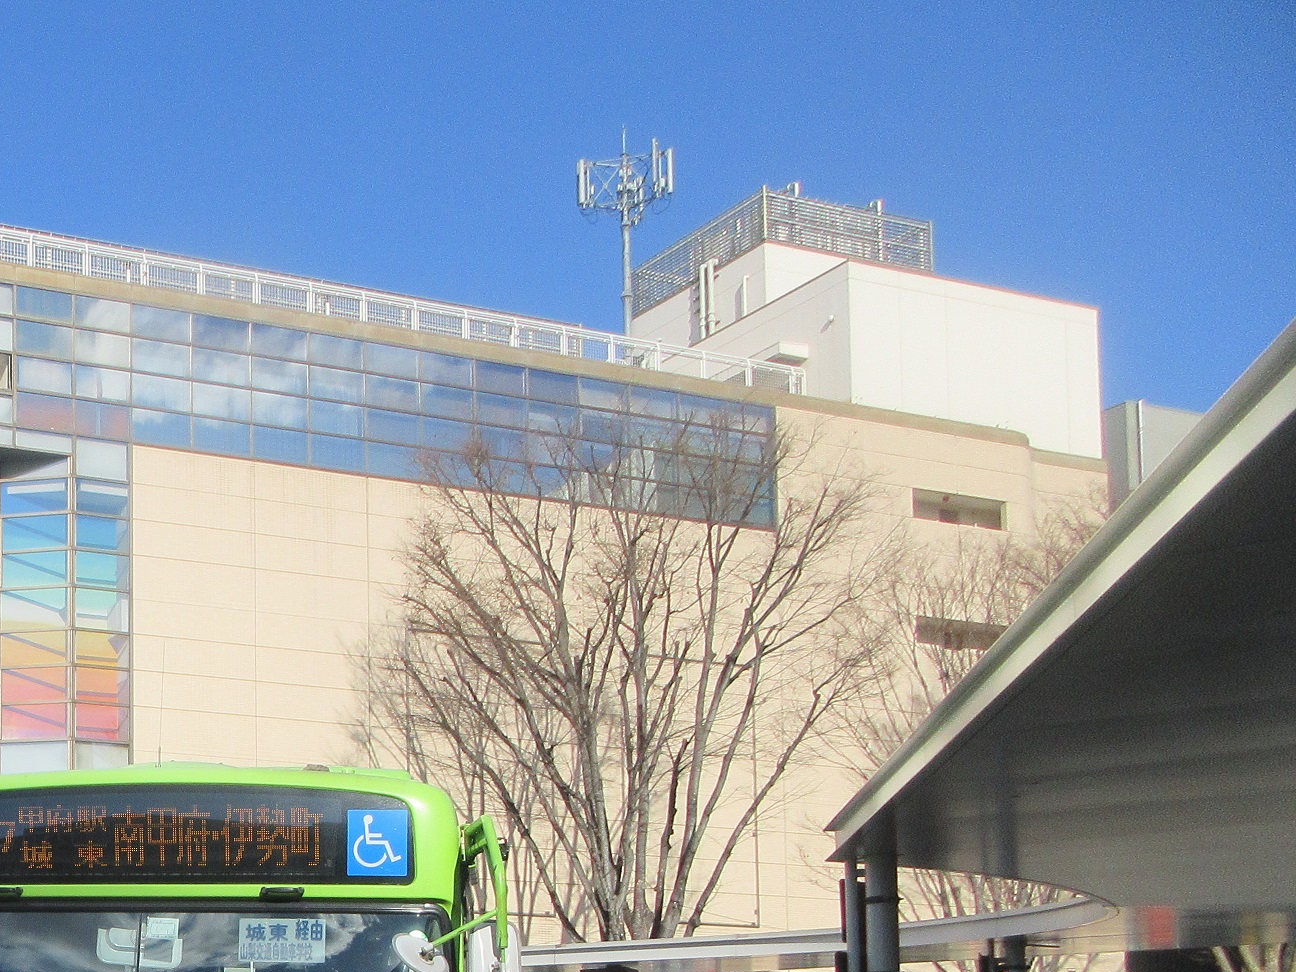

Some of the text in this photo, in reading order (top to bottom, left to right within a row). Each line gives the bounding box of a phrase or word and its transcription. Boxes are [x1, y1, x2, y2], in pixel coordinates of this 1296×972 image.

[18, 804, 107, 833] 甲府駅
[245, 919, 323, 942] 城東 経由
